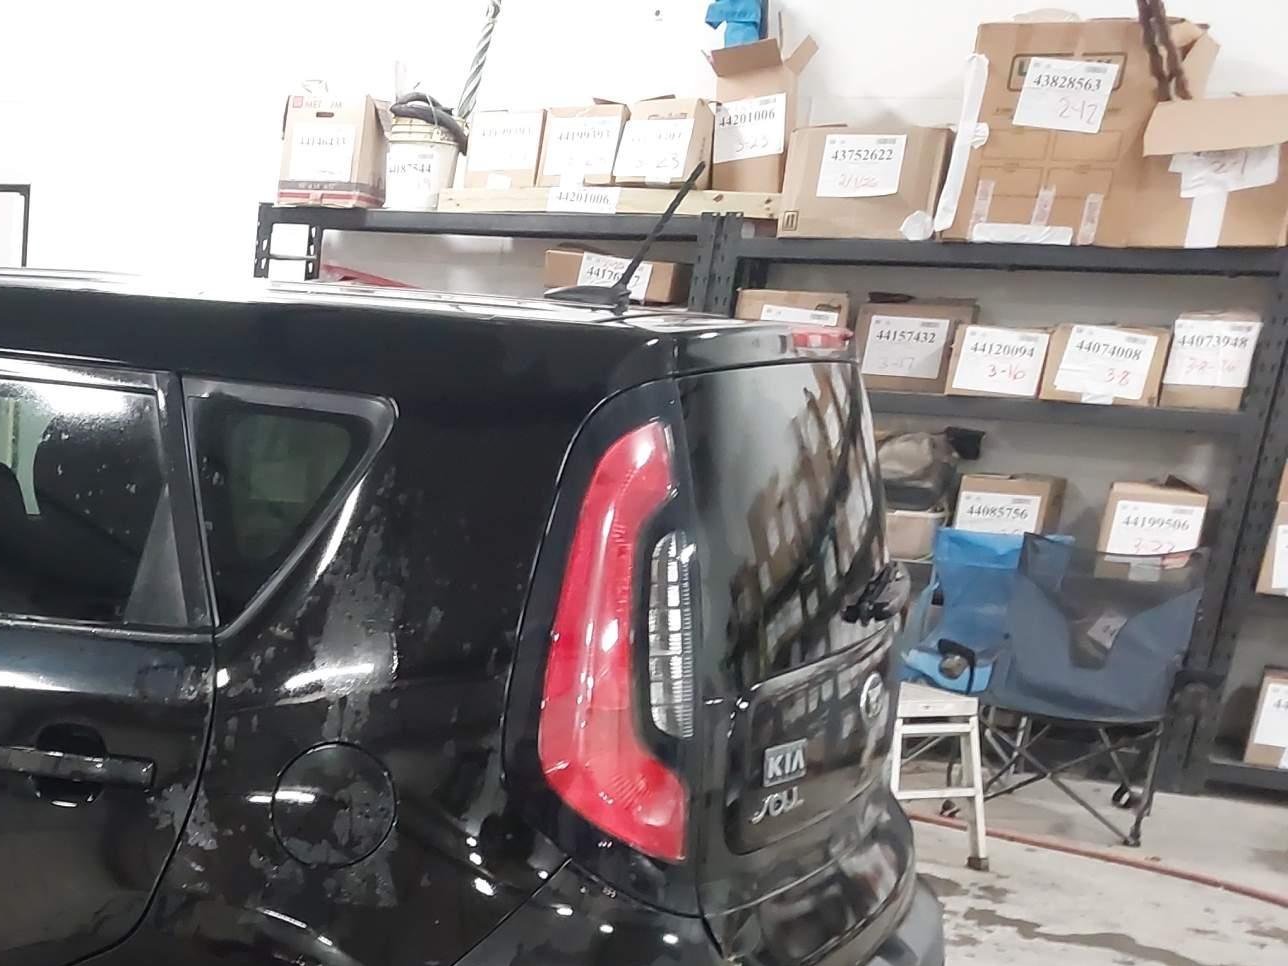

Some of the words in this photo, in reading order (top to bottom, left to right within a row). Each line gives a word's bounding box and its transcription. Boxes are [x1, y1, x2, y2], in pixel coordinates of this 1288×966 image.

[1033, 74, 1102, 92] 43828563
[719, 108, 776, 128] 44201006
[831, 149, 894, 162] 43752622
[556, 191, 610, 205] 44201006
[875, 329, 936, 344] 44157432
[1177, 335, 1249, 348] 44073948
[970, 341, 1036, 358] 44120094
[1075, 339, 1143, 361] 44074008
[966, 504, 1029, 520] 44085756
[1122, 515, 1190, 531] 44199506
[767, 749, 805, 778] KIA
